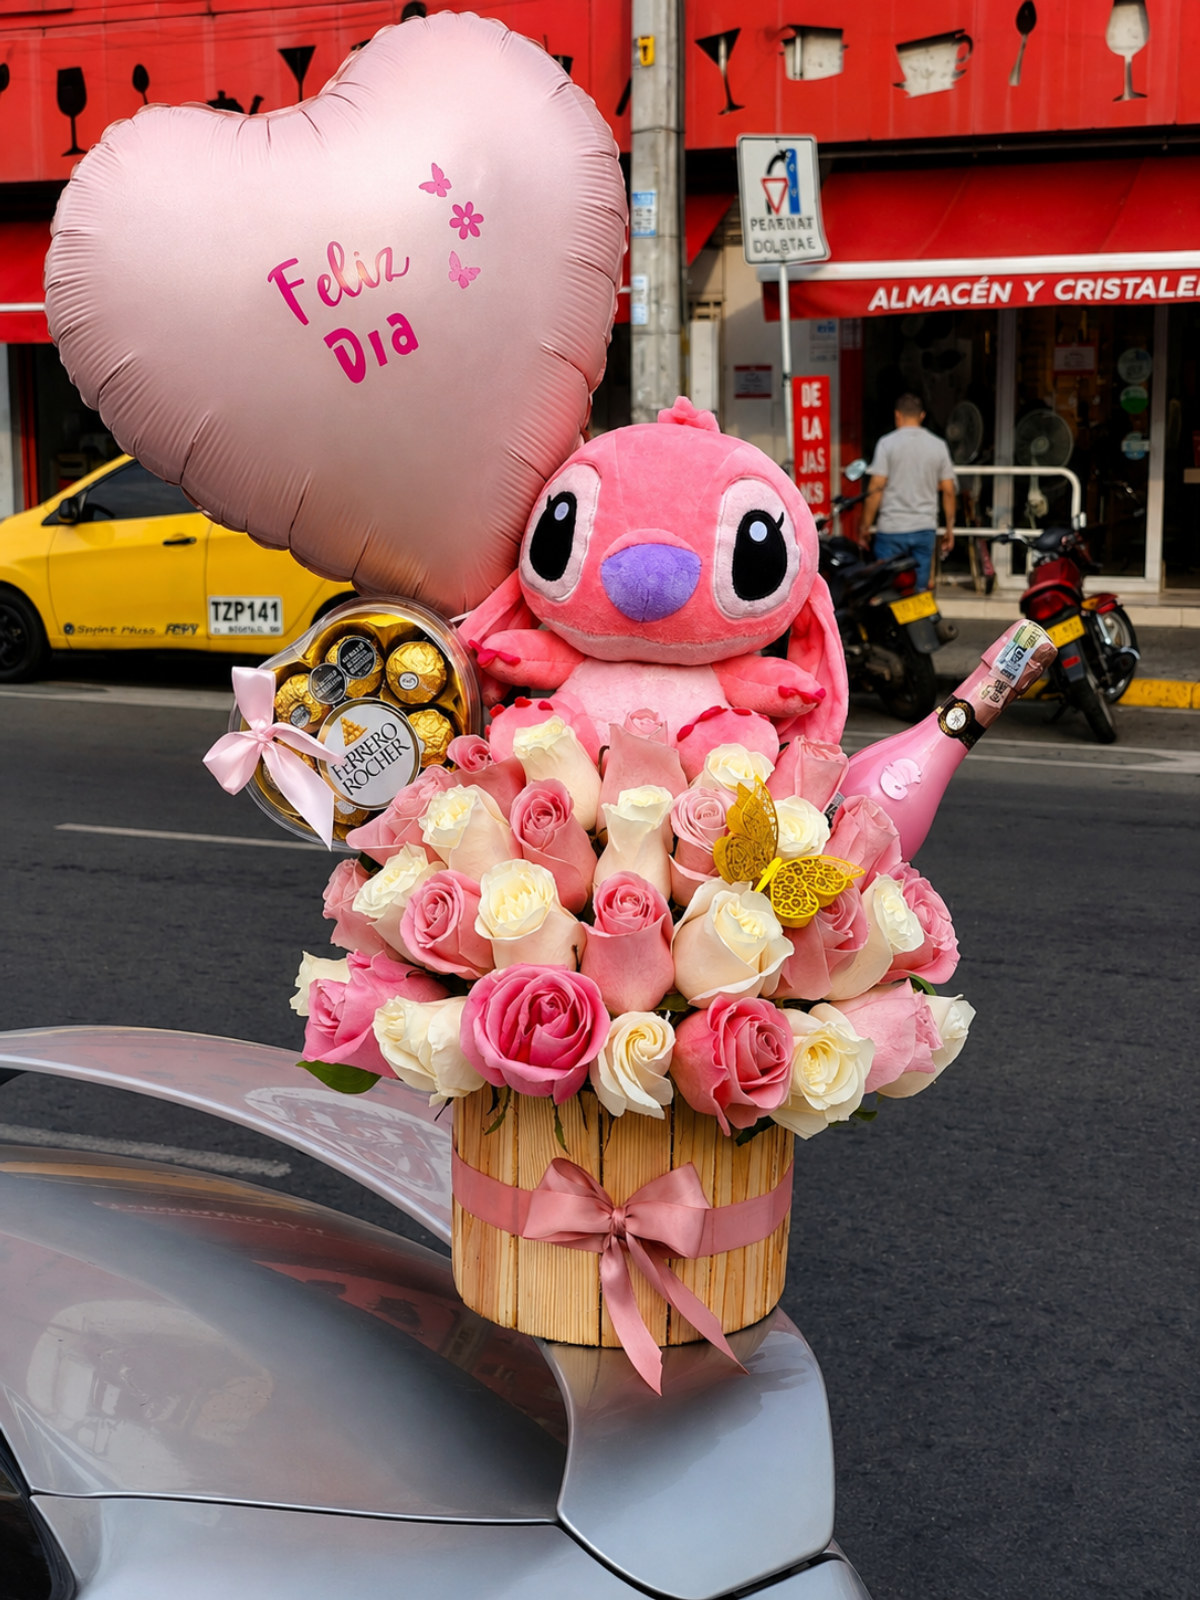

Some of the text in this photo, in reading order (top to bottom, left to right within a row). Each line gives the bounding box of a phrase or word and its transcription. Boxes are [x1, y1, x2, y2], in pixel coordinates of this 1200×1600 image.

[267, 240, 410, 326] Feliz
[867, 275, 1200, 311] ALMACÉN Y CRISTALE
[801, 381, 822, 408] DE
[801, 416, 823, 441] LA
[211, 601, 278, 622] TZP141
[331, 722, 398, 781] FERRERO
[342, 738, 411, 796] ROCHER
